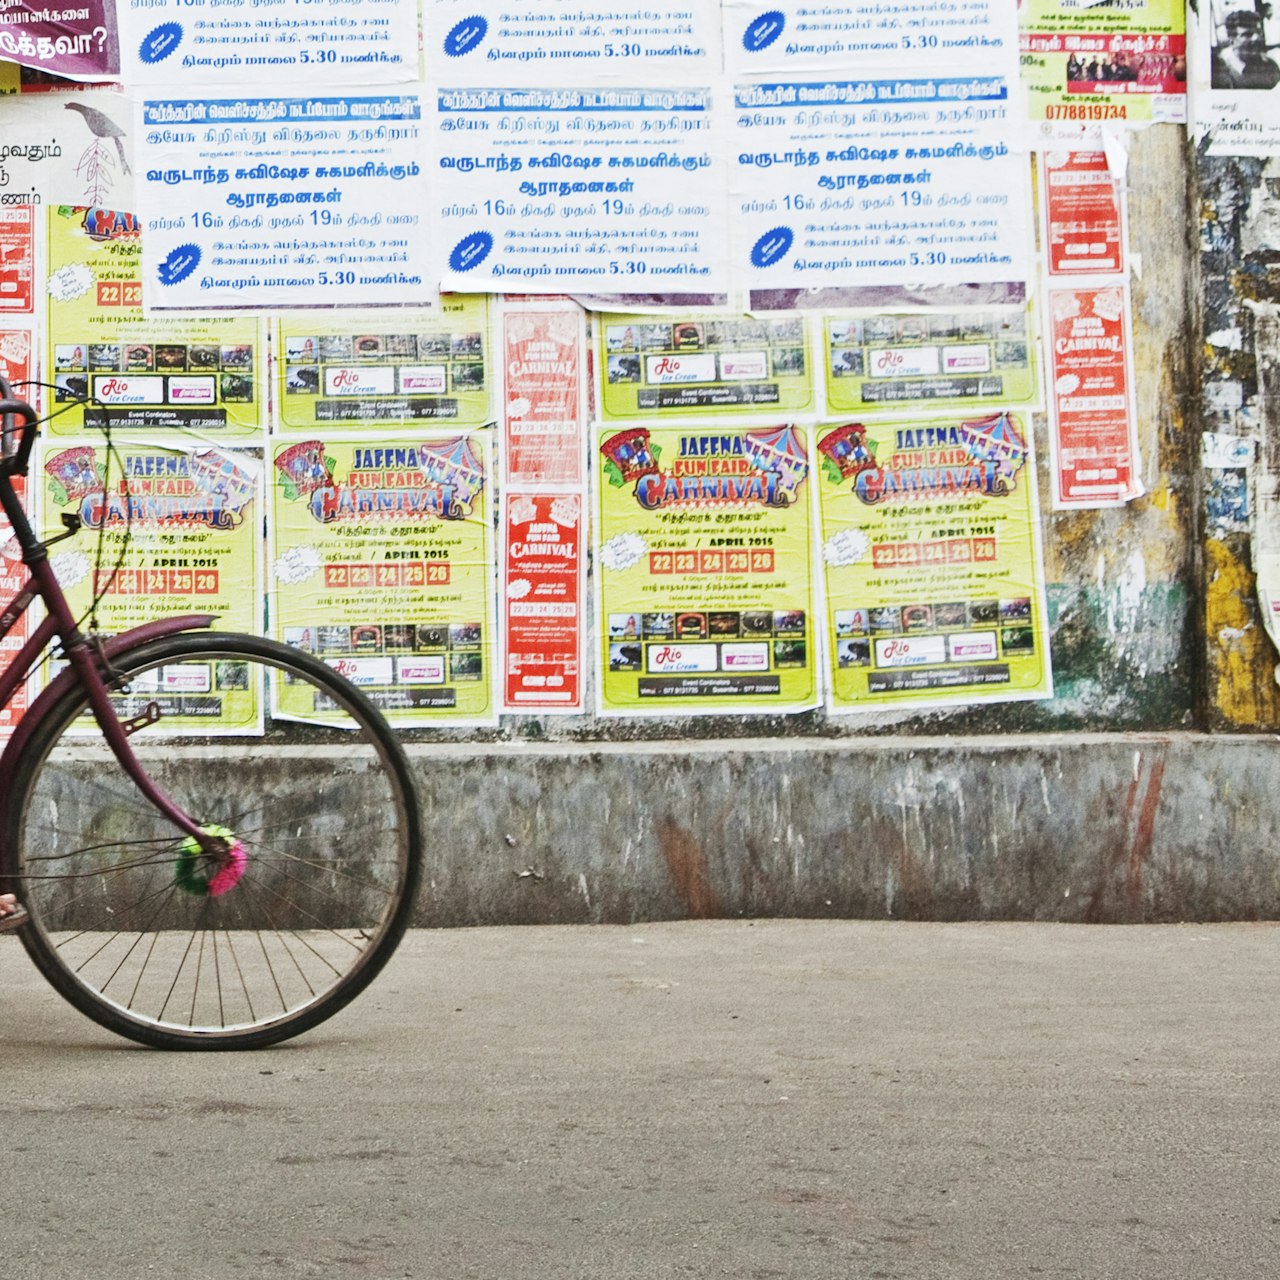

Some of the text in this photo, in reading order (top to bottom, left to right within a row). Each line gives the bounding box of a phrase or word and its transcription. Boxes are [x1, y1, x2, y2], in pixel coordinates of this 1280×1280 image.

[300, 50, 337, 63] 5.30
[604, 44, 641, 57] 5.30
[146, 166, 229, 185] வருடாந்த
[910, 252, 946, 265] 5.30
[609, 261, 646, 274] 5.30
[318, 272, 355, 285] 5.30
[1056, 336, 1123, 354] CARNIVAL
[680, 436, 743, 456] JAFFNA
[674, 459, 750, 475] FUN FAIR
[634, 471, 790, 509] CARNIVAL
[308, 484, 465, 522] CARNIVAL
[510, 542, 577, 559] CARNIVAL
[709, 538, 745, 547] APRIL
[749, 538, 773, 546] 2015
[384, 551, 449, 560] APRIL 2015
[653, 553, 771, 570] 22 23 24 25 26
[655, 647, 682, 663] Rio
